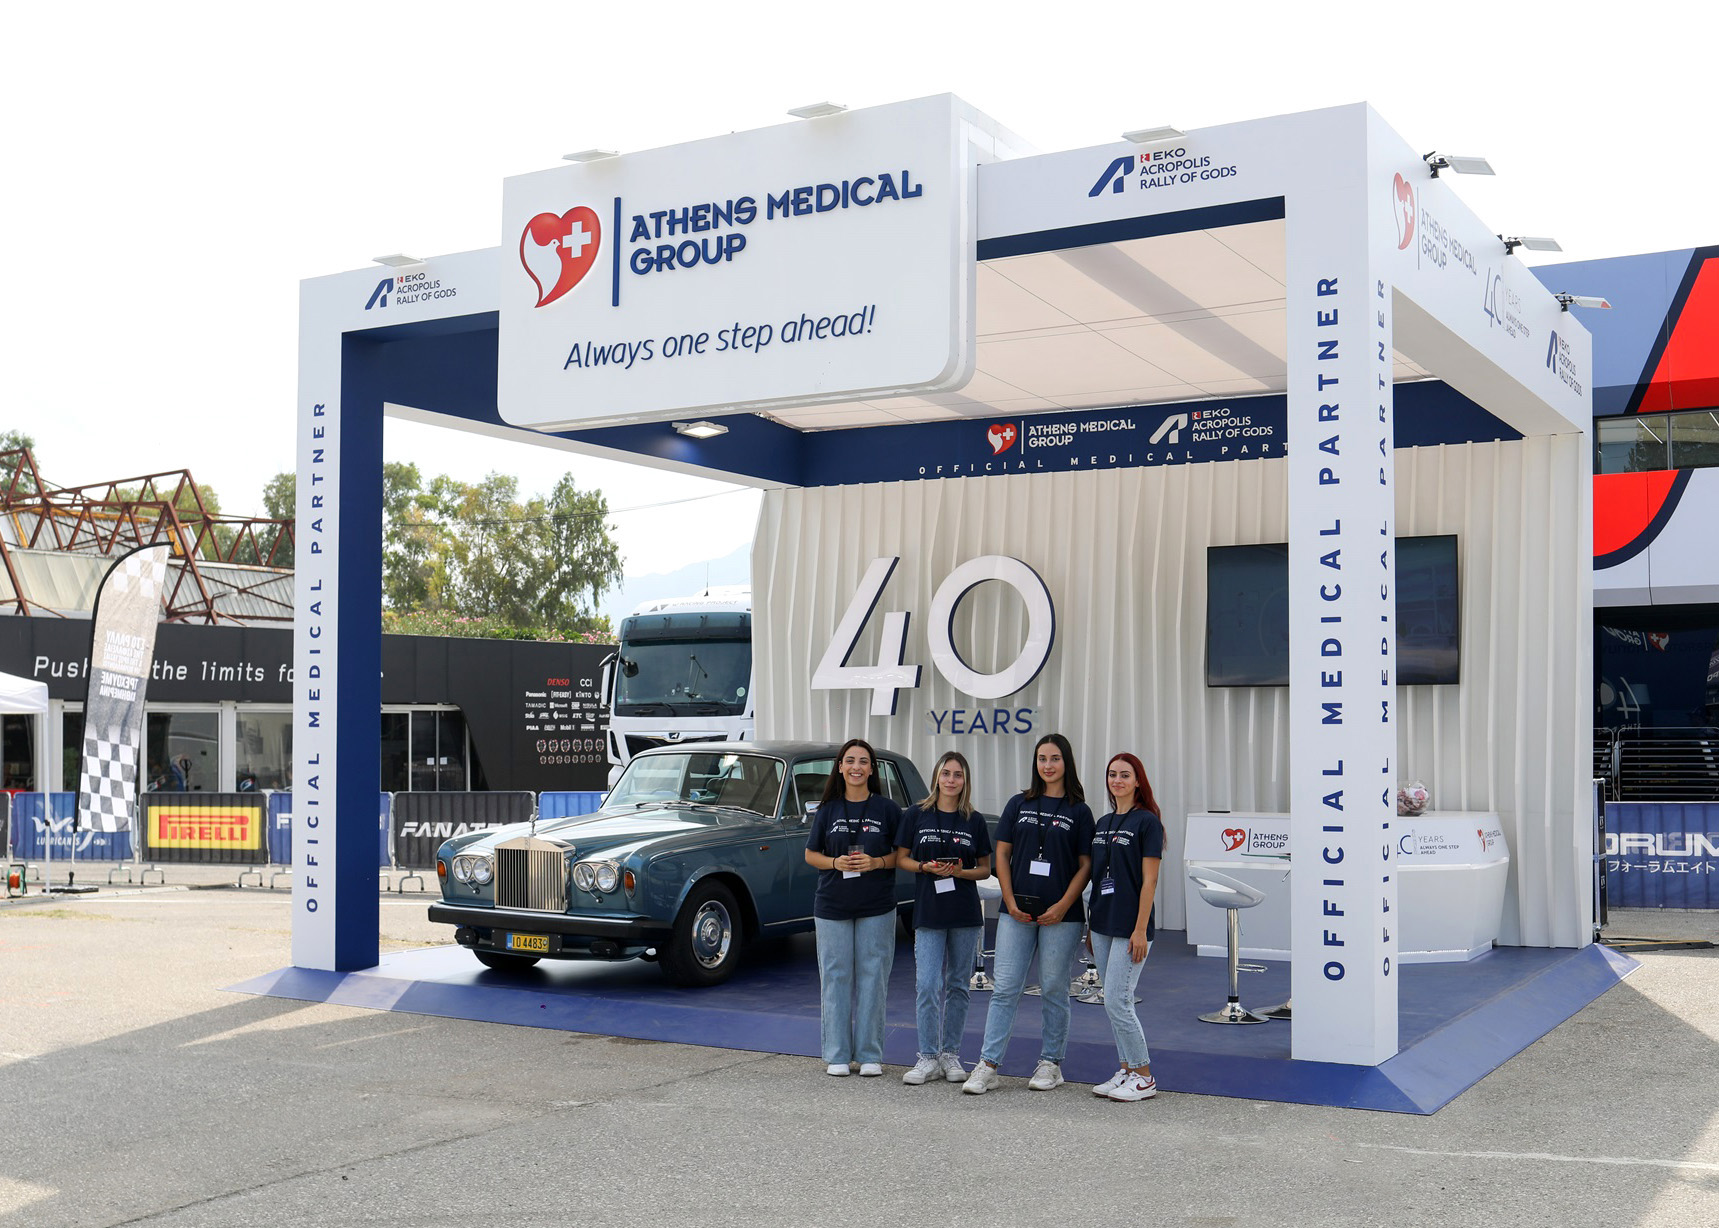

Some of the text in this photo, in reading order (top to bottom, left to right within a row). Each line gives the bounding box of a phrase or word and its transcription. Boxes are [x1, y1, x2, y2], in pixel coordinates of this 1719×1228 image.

[1153, 148, 1186, 160] EKO
[1140, 156, 1210, 176] ACROPOLIS
[1140, 166, 1237, 189] RALLY OF GODS
[630, 170, 922, 243] ATHENS MEDICAL
[1421, 208, 1477, 276] ATHENS MEDICAL
[1422, 234, 1447, 270] GROUP
[630, 232, 747, 276] GROUP
[397, 280, 440, 294] ACROPOLIS
[405, 273, 425, 282] EKO
[397, 288, 456, 305] RALLY OF GODS
[563, 304, 876, 370] Always one step ahead!
[1192, 416, 1251, 431] ACROPOLIS
[1203, 408, 1230, 418] EKO
[1028, 418, 1136, 436] ATHENS MEDICAL
[1192, 426, 1273, 442] RALLY OF GODS
[1028, 435, 1073, 448] GROUP
[919, 460, 1043, 474] OFFICIAL
[1070, 450, 1193, 466] MEDICAL
[811, 554, 1056, 716] 40
[1317, 278, 1345, 981] OFFICIAL MEDICAL PARTNER
[1377, 279, 1390, 976] OFFICIAL MEDICAL PARTNER
[306, 403, 325, 912] OFFICIAL MEDICAL PARTNER
[152, 660, 188, 680] the
[202, 661, 264, 681] limits
[547, 678, 570, 686] DENSO
[930, 708, 1033, 735] YEARS
[159, 815, 249, 841] PIRELLI
[36, 837, 80, 845] LURICANS
[1608, 859, 1716, 874] フォーラムエイト
